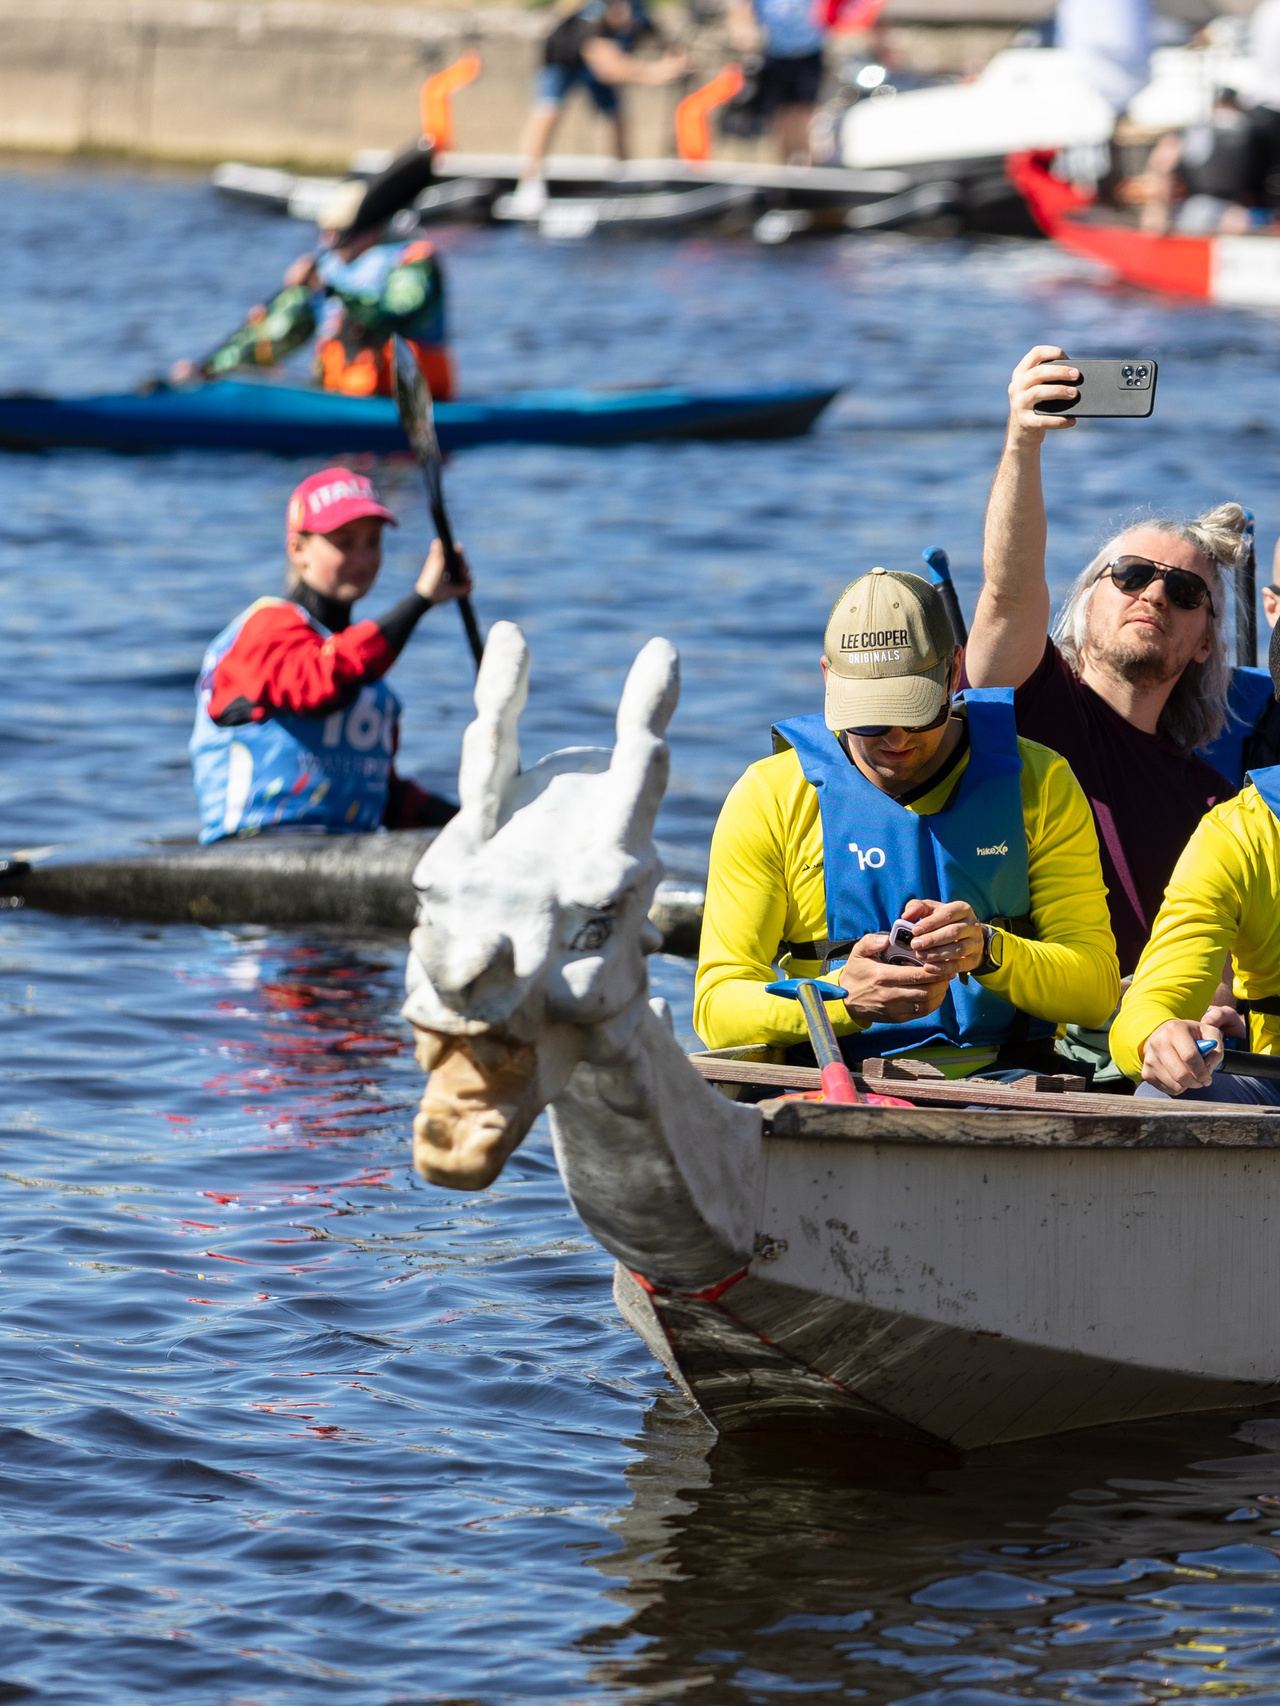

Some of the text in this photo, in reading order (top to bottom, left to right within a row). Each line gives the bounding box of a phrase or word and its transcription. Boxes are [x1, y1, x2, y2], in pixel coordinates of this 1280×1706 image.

[841, 629, 908, 649] LEE COOPER
[848, 650, 900, 664] ORIGINALS
